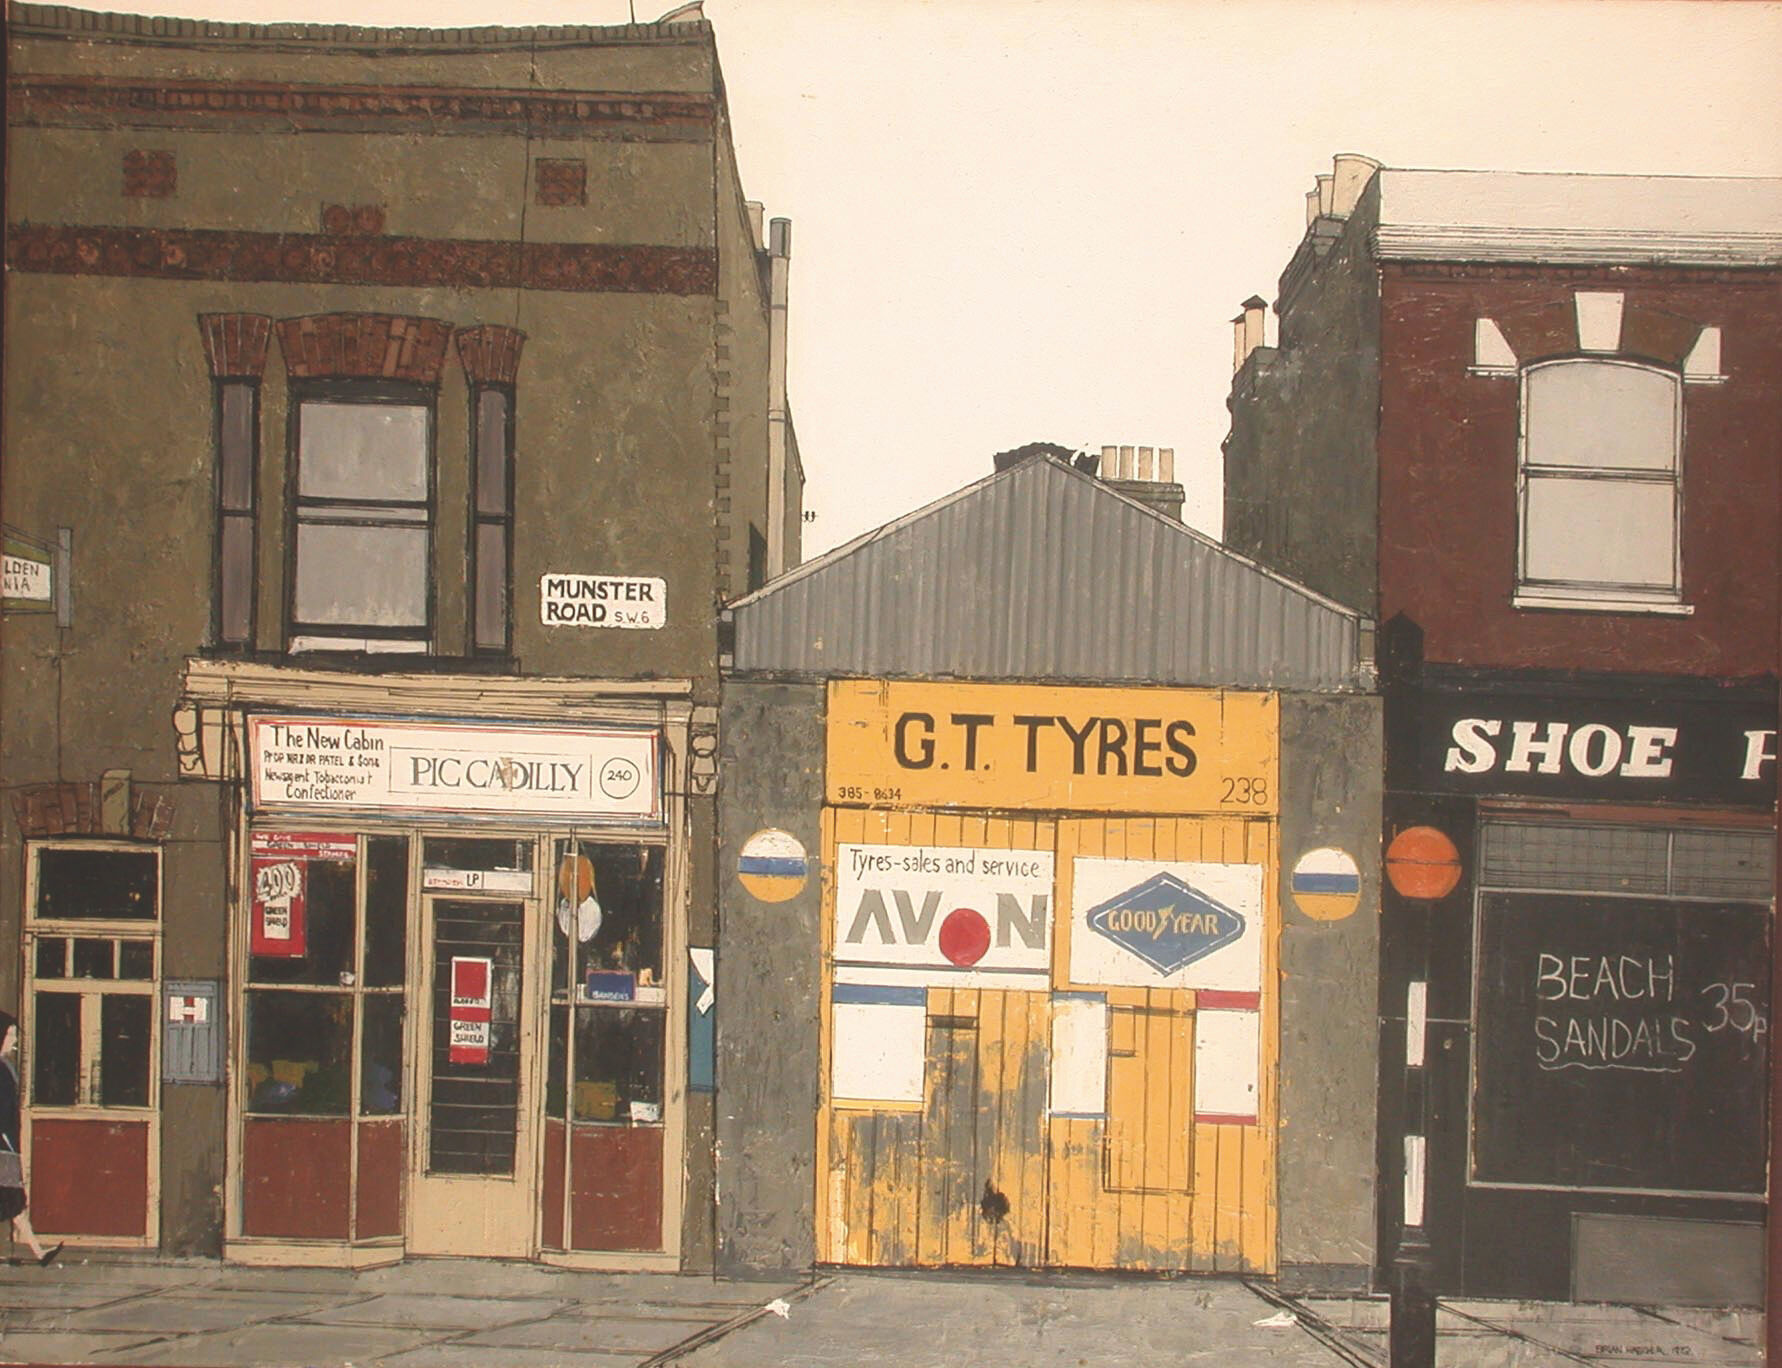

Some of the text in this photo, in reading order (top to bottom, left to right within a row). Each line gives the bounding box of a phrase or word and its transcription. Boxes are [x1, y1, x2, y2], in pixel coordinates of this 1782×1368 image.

[547, 579, 654, 601] MUNSTER
[547, 601, 607, 622] ROAD
[270, 725, 384, 751] The New Cabin
[893, 711, 1198, 778] G.T. TYRES
[1444, 718, 1678, 777] SHOE
[319, 754, 345, 767] PATEL
[265, 768, 373, 785] Newsagent Tobacconist
[409, 756, 585, 792] PICCADILLY
[606, 769, 633, 782] 240
[286, 783, 356, 801] Confectioner
[1220, 777, 1269, 806] 238
[945, 850, 976, 875] and
[981, 858, 1040, 878] service
[1535, 953, 1674, 1001] BEACH
[1701, 982, 1768, 1044] 35p
[453, 1022, 482, 1032] GREEN
[453, 1033, 485, 1044] SHIELD
[1534, 1015, 1697, 1063] SANDALS
